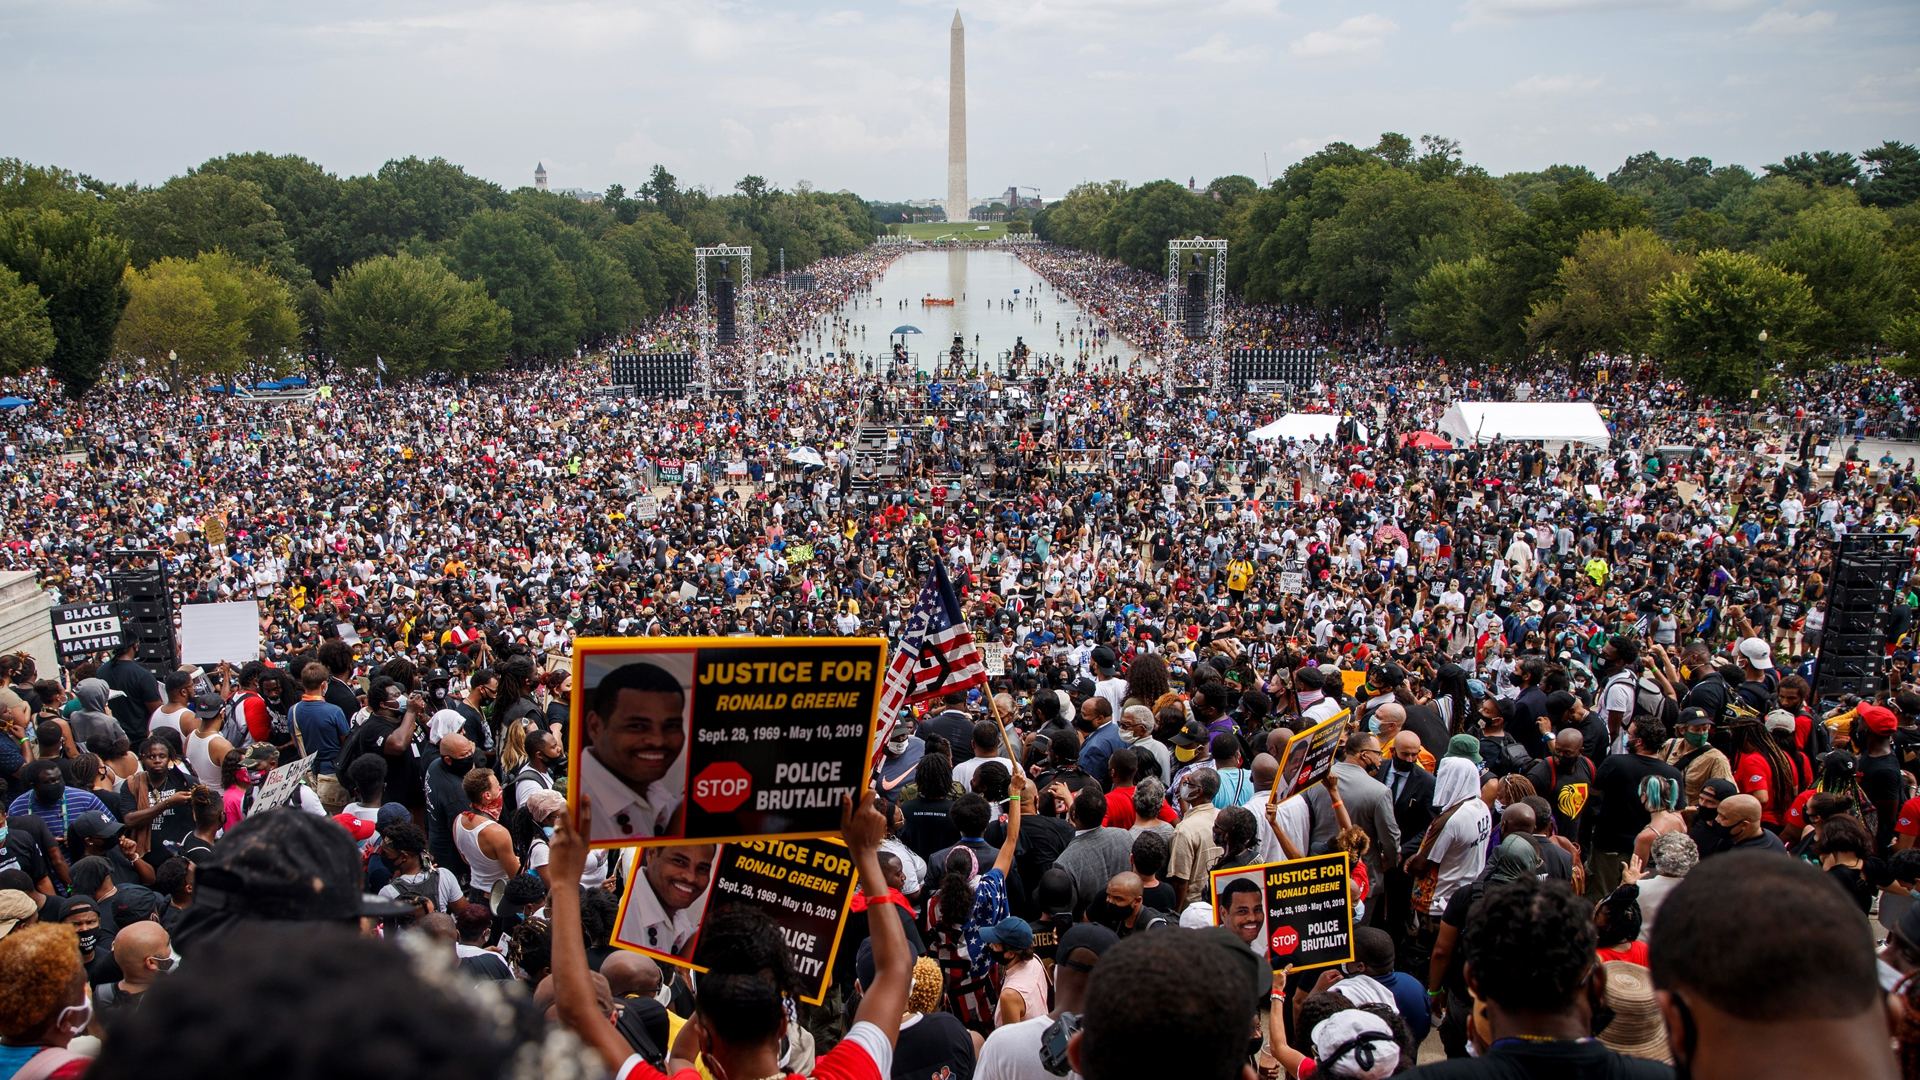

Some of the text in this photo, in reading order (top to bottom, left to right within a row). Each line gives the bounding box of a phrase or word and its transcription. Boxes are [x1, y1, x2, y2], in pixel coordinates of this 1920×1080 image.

[64, 605, 110, 621] BLACK
[69, 621, 112, 635] LIVES
[62, 635, 121, 652] MATTER
[699, 661, 872, 685] JUSTICE FOR
[716, 692, 860, 711] RONALD GREENE
[698, 729, 728, 744] Sept.
[731, 728, 749, 742] 28,
[753, 727, 780, 740] 1969
[789, 726, 813, 741] May
[816, 725, 832, 739] 10,
[835, 724, 863, 737] 2019
[775, 762, 842, 783] POLICE
[697, 779, 748, 797] STOP
[731, 840, 851, 876] USTICE FOR
[735, 856, 839, 894] RONALD GREENE
[1267, 864, 1344, 886] JUSTICE FOR
[718, 877, 739, 893] Sept.
[741, 884, 754, 899] 28,
[757, 889, 777, 903] 1969
[782, 896, 800, 912] May
[802, 902, 813, 916] 10,
[815, 906, 836, 920] 2019
[1276, 881, 1340, 900] RONALD GREENE
[1270, 909, 1284, 917] Sept.
[1285, 906, 1294, 915] 28,
[1295, 904, 1307, 913] 1969
[1311, 902, 1322, 911] May
[1323, 901, 1331, 909] 10,
[1332, 898, 1345, 907] 2019
[1308, 920, 1339, 936] POLICE
[1273, 934, 1297, 947] STOP
[1301, 933, 1347, 952] BRUTALITY
